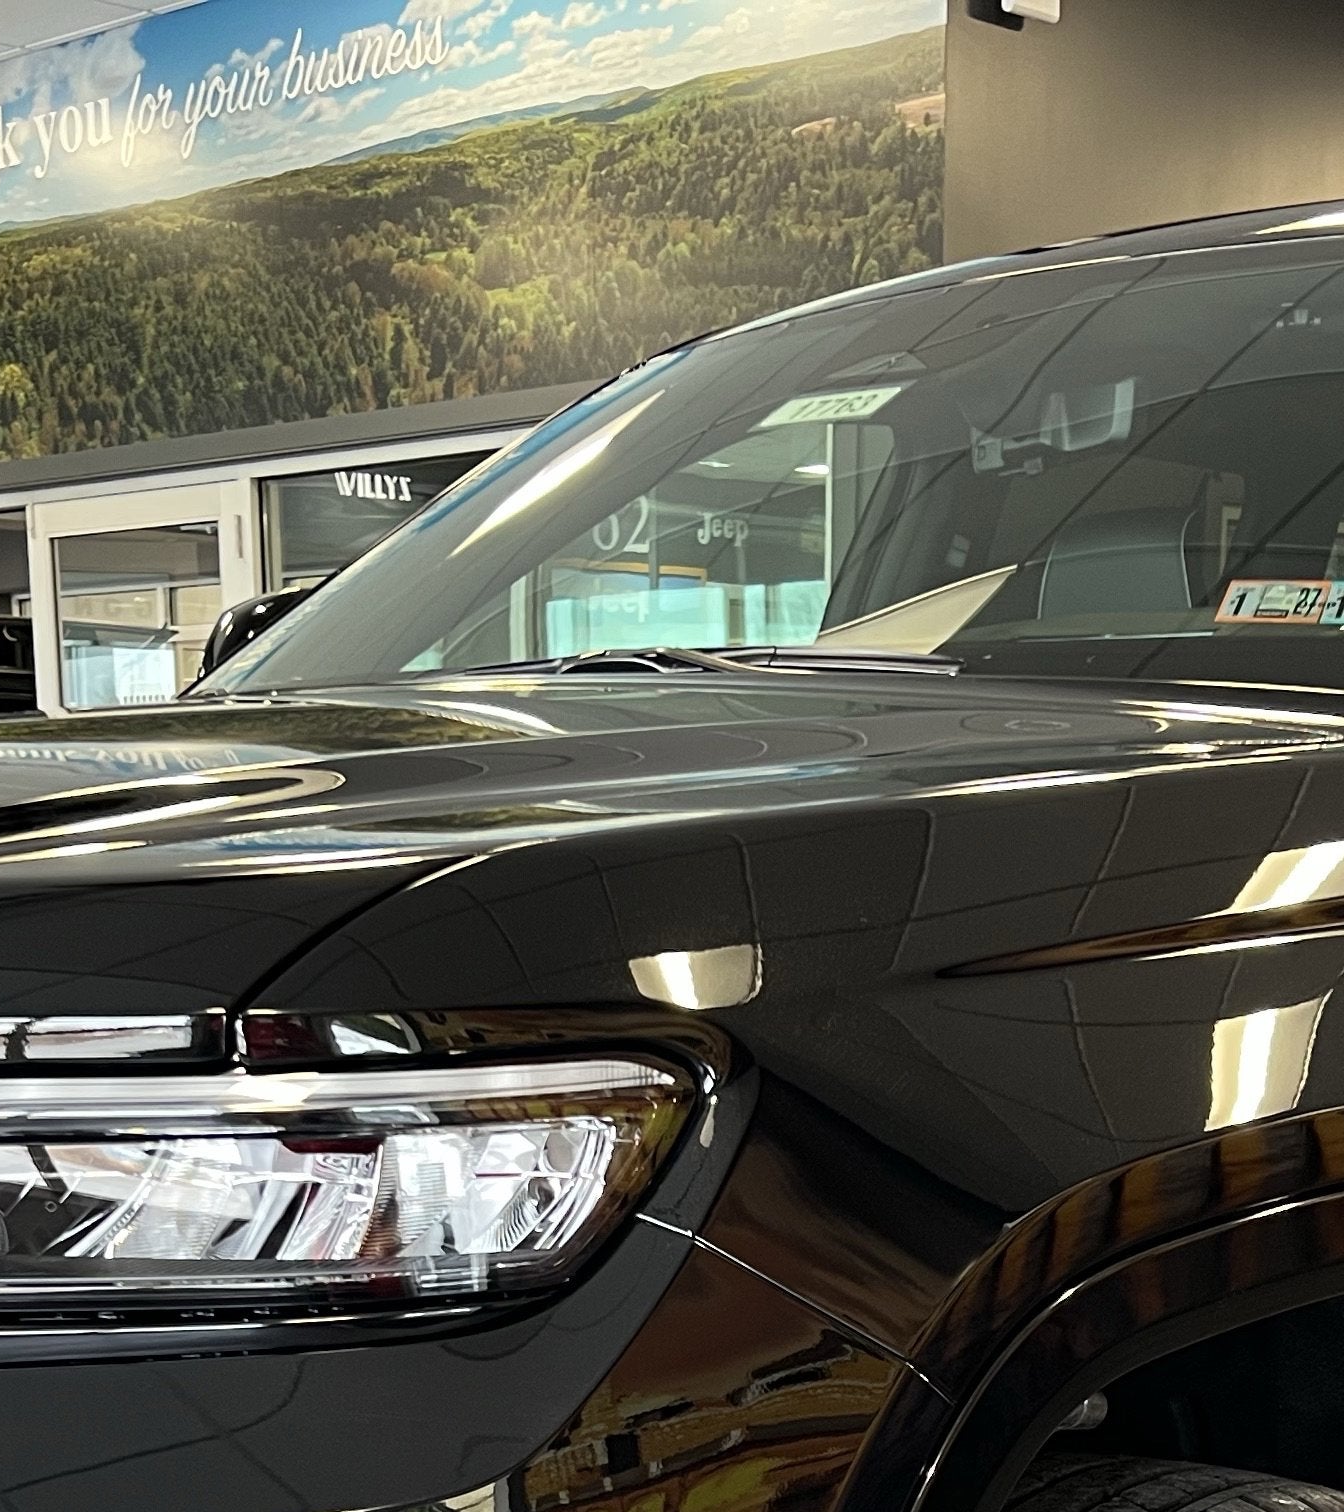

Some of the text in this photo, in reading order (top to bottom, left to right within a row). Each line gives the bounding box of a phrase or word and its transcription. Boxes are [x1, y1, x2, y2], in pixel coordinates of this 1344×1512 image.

[33, 97, 113, 179] you
[120, 73, 176, 168] for
[180, 61, 274, 160] your
[282, 16, 449, 100] business
[334, 471, 412, 502] WILLYS
[697, 511, 749, 548] Jeep
[1292, 587, 1323, 618] 27
